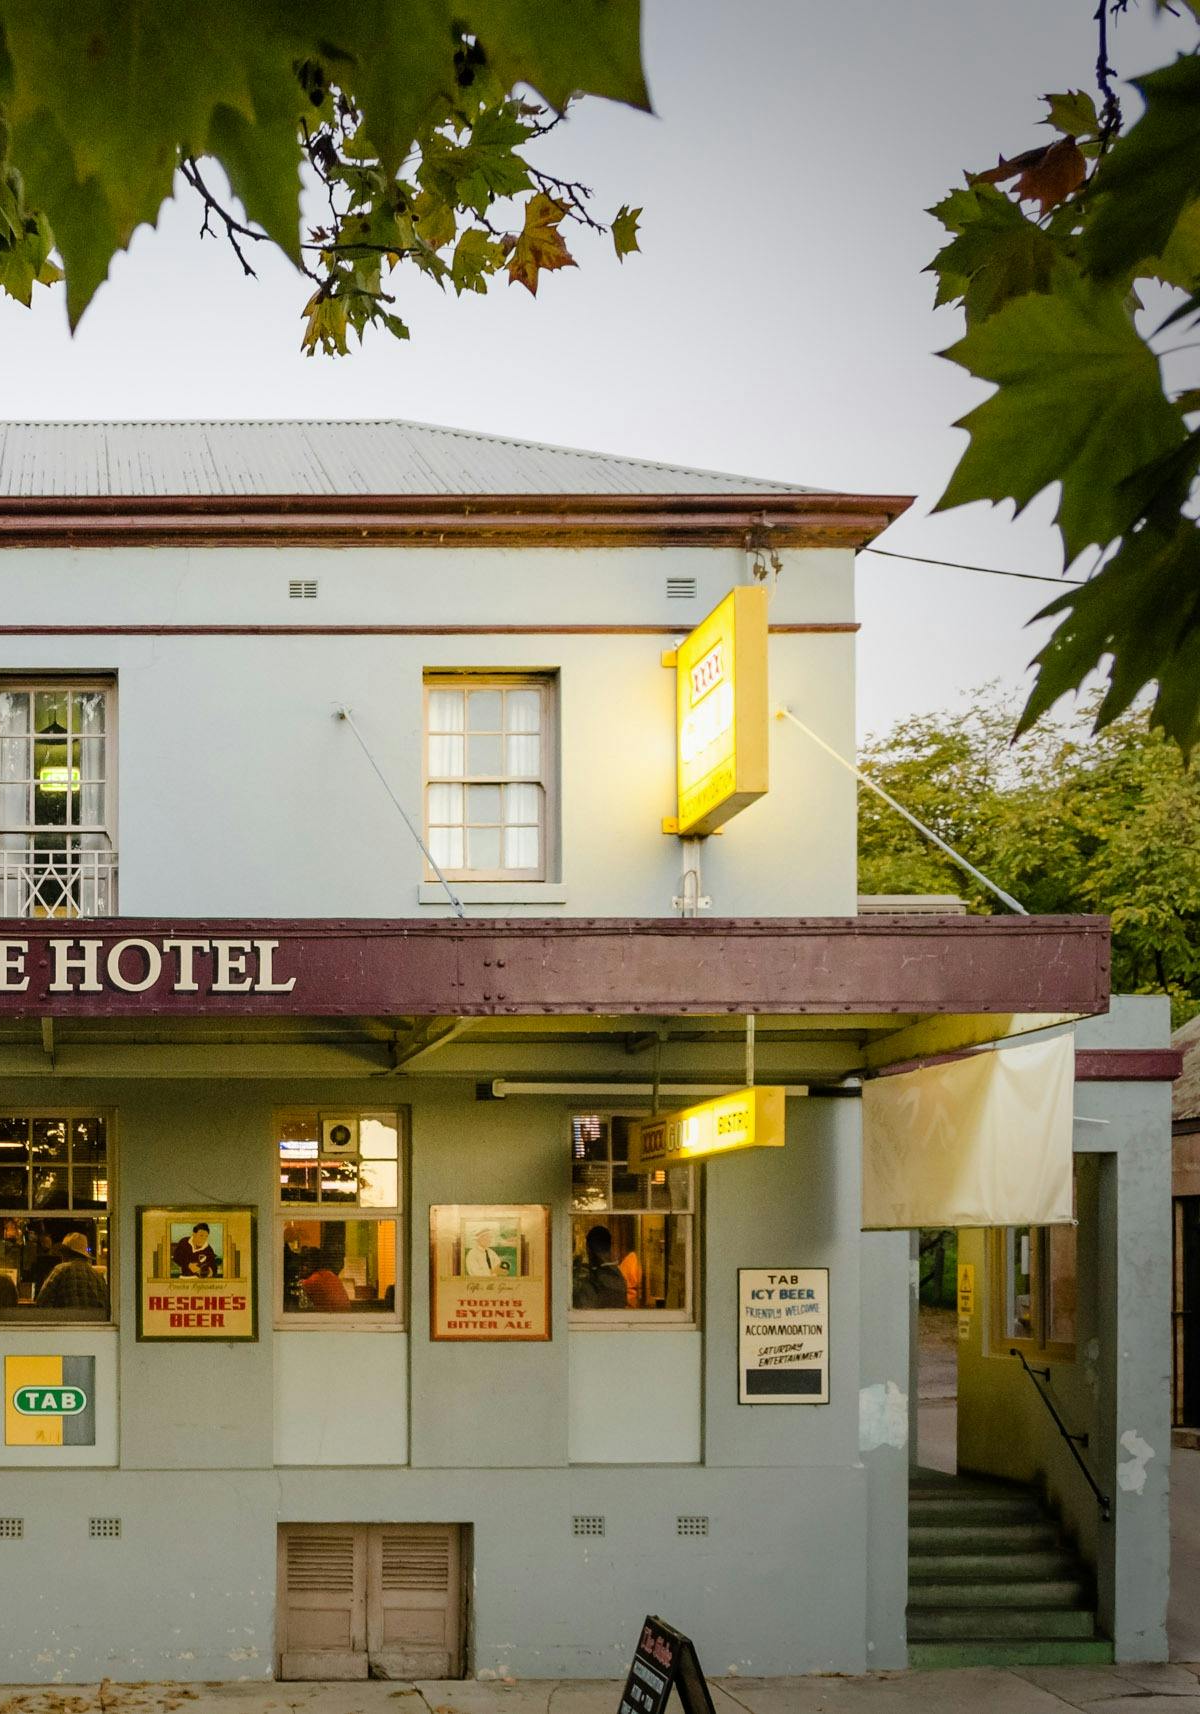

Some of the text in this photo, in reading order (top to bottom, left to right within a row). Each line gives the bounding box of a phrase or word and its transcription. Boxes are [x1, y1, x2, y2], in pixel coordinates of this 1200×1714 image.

[693, 654, 721, 693] XXXX
[49, 938, 297, 993] HOTEL
[767, 1275, 799, 1285] TAB
[751, 1289, 815, 1300] ICY BEER
[456, 1309, 527, 1318] SYDNEY
[745, 1303, 820, 1318] FRIENDLY WELCOME
[170, 1313, 225, 1328] BEER
[447, 1320, 534, 1329] BITTER ALE
[745, 1325, 823, 1336] ACCOMMODATION
[757, 1343, 804, 1357] SATURDAY
[758, 1350, 823, 1367] ENTERTAINMENT
[25, 1392, 77, 1409] TAB
